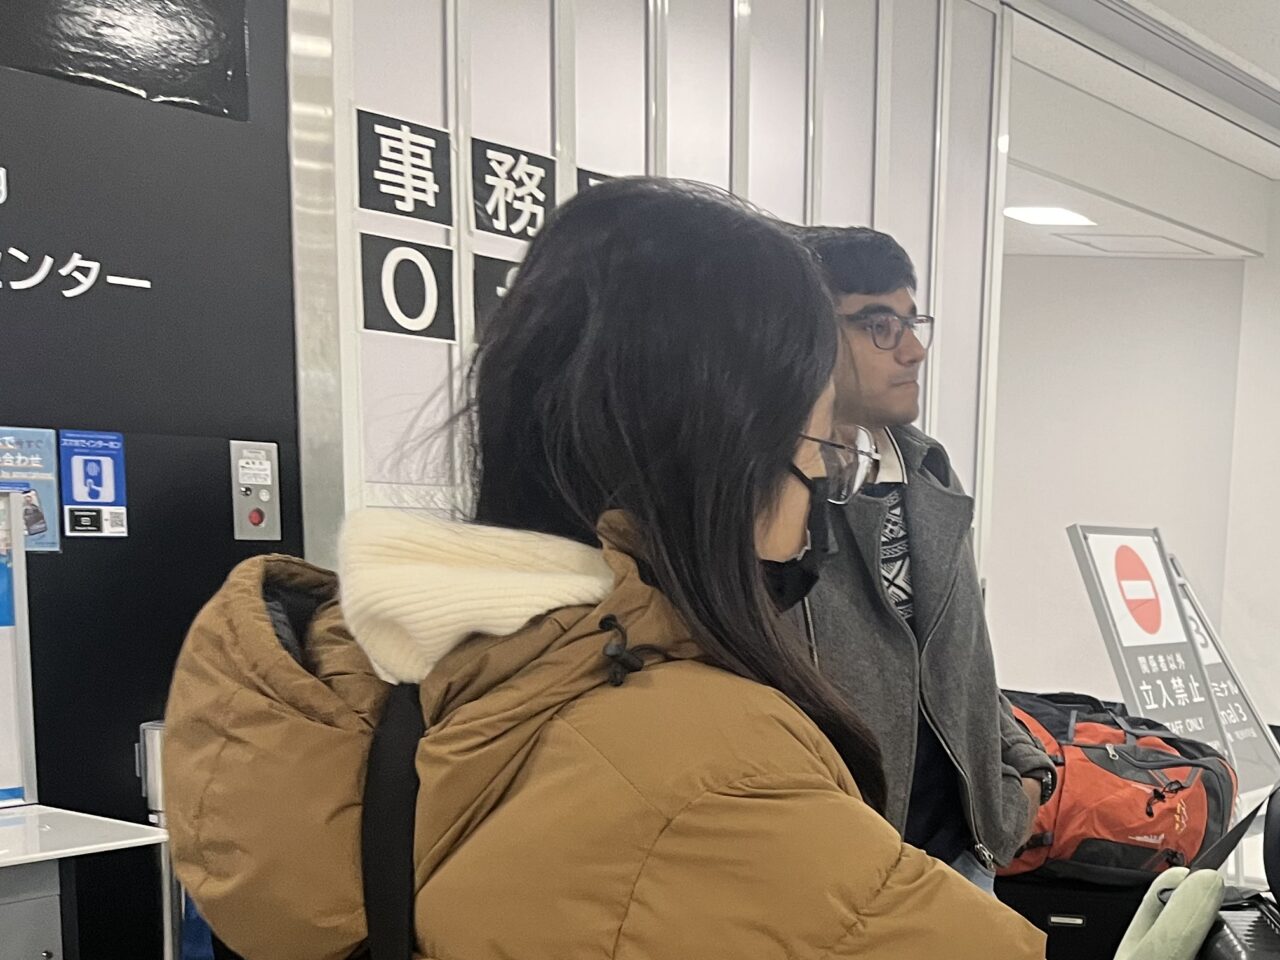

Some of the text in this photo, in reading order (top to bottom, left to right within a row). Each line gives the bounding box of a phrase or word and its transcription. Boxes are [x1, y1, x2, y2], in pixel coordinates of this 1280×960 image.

[373, 124, 606, 237] 事務
[0, 247, 152, 298] ンター
[0, 452, 43, 467] 合わせ
[1139, 673, 1206, 710] 立入禁止
[1185, 716, 1206, 733] ONLY
[1233, 702, 1248, 722] 3
